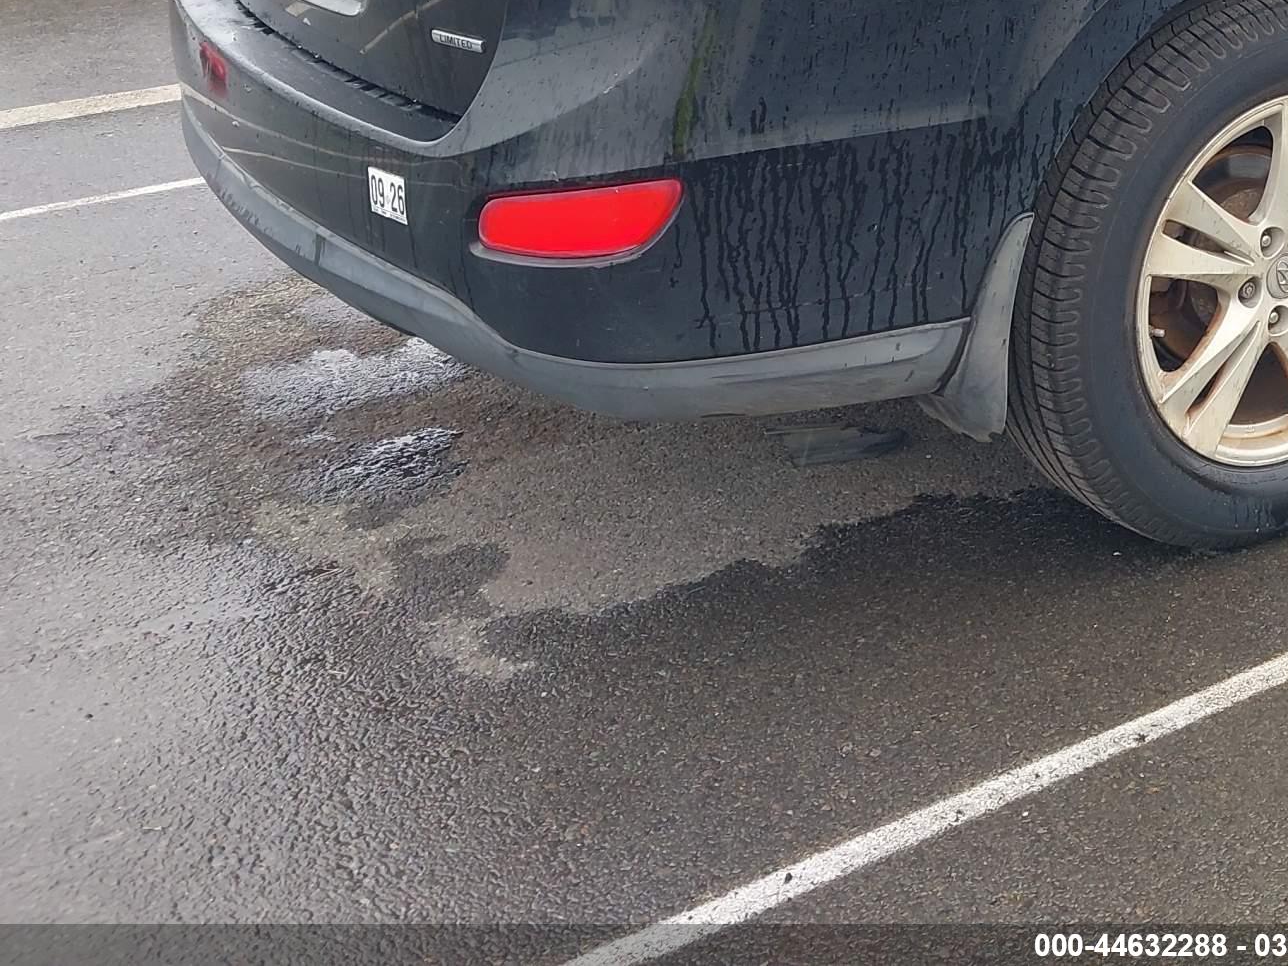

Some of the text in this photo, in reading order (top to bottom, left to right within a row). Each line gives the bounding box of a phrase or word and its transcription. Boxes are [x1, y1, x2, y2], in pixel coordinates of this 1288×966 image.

[440, 34, 473, 50] LIMITED
[371, 174, 385, 208] 09
[390, 182, 405, 216] 26
